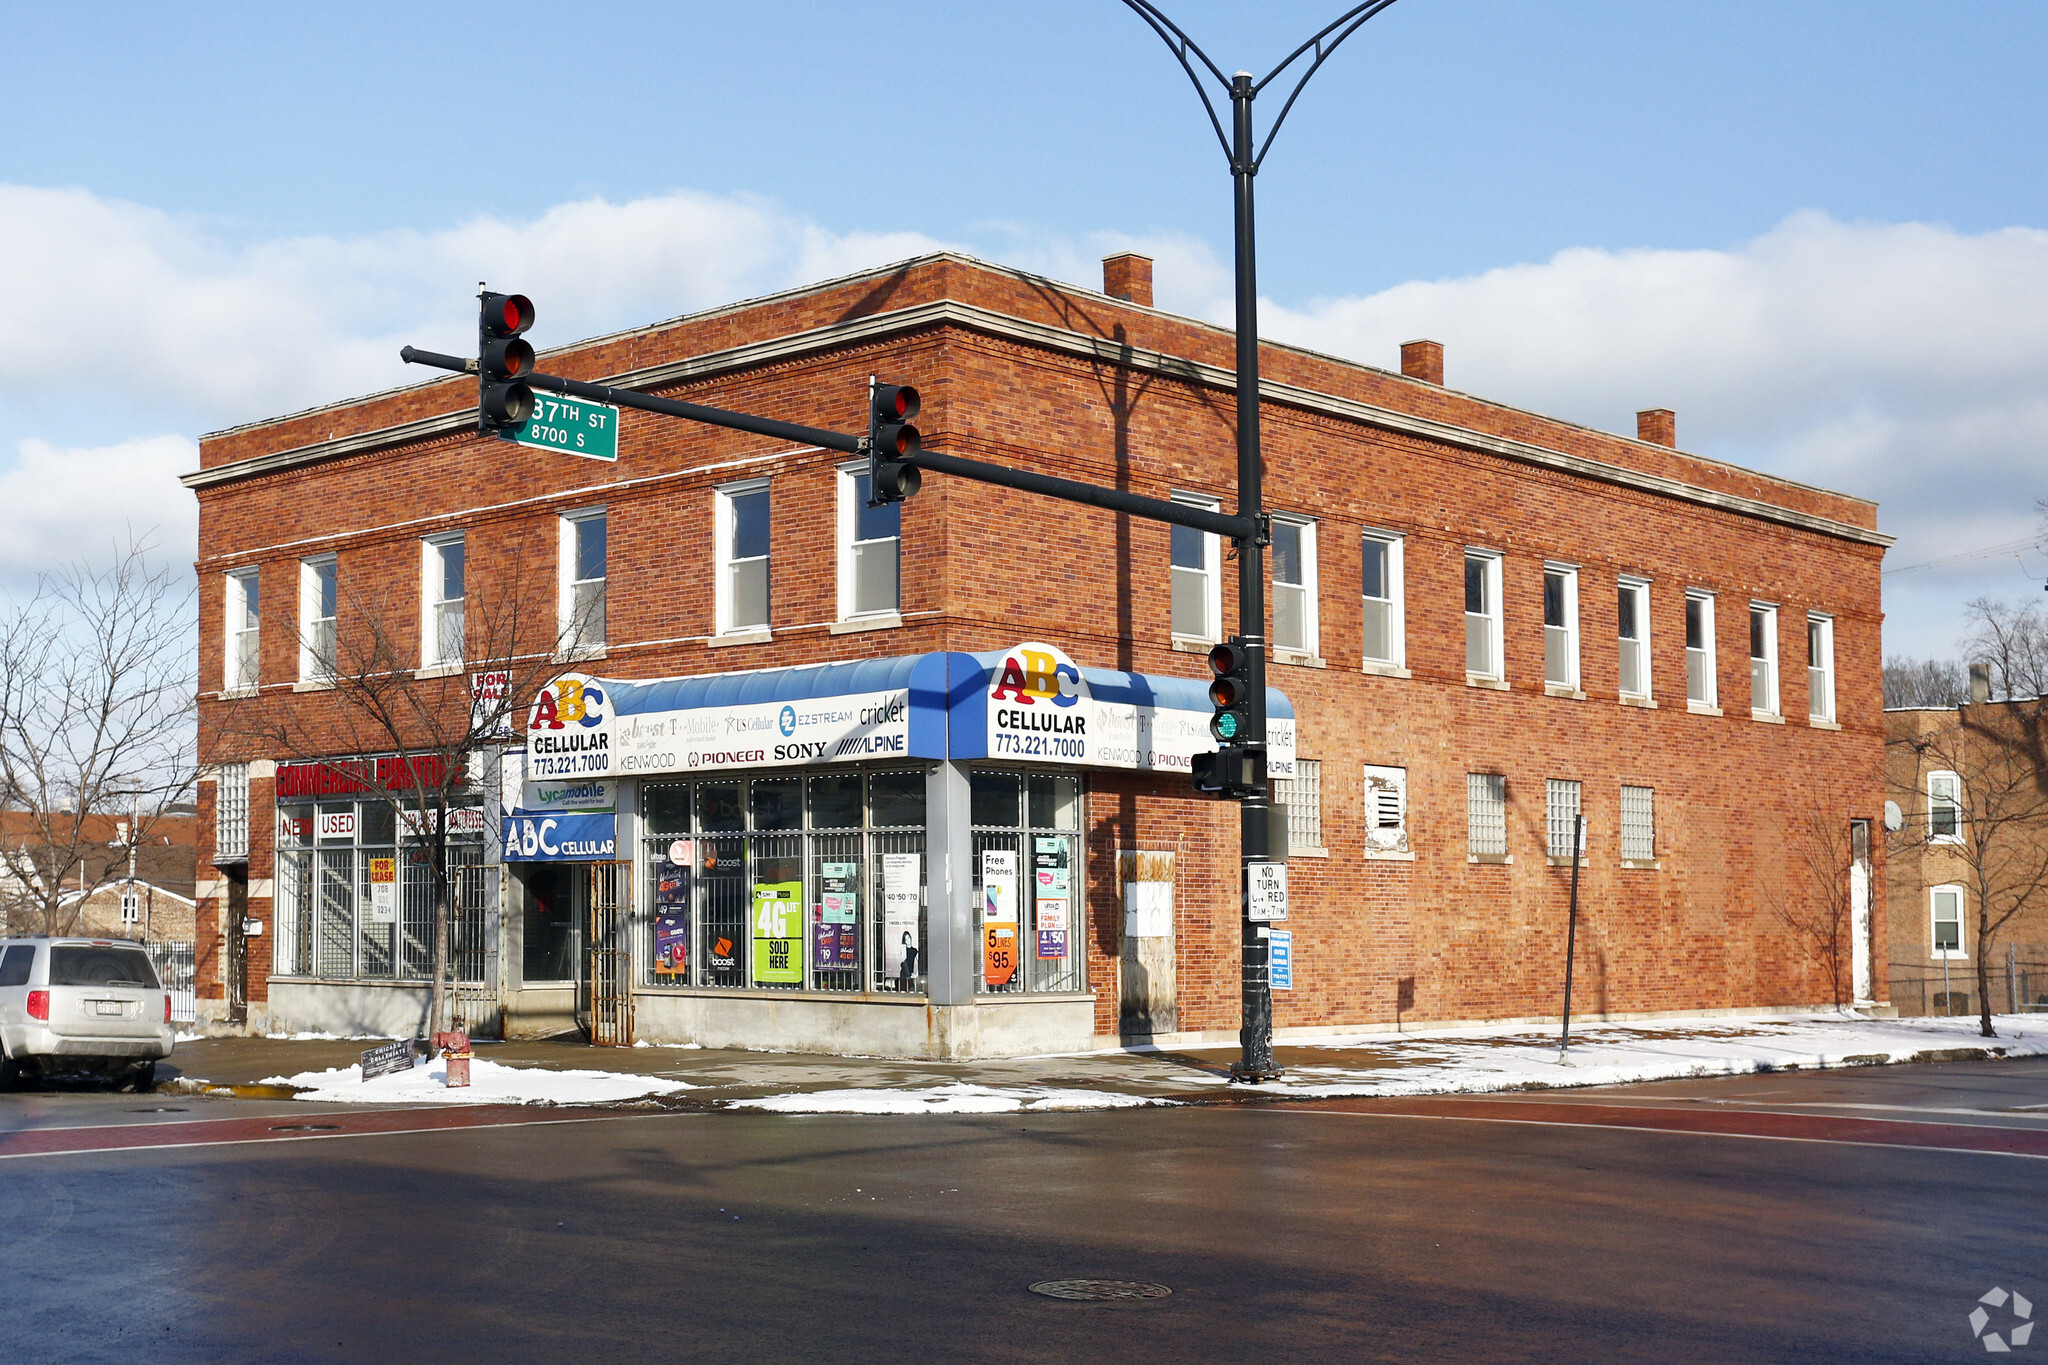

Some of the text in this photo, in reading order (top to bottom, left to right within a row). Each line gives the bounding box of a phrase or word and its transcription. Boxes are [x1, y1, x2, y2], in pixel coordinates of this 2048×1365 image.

[588, 413, 606, 429] ST
[531, 424, 584, 448] 8700 S
[991, 649, 1080, 708] ABC
[530, 679, 604, 730] ABC
[798, 710, 853, 726] EZSTREAM
[860, 694, 905, 726] cricket
[997, 708, 1086, 734] CELLULAR
[534, 732, 609, 754] CELLULAR
[620, 734, 904, 770] KENWOOD PIONEER SONY ALPINE
[996, 734, 1085, 758] 773.221.7000
[534, 753, 609, 776] 773.221.7000
[1097, 747, 1142, 764] KENWOOD
[1158, 754, 1194, 767] PIONE
[275, 753, 464, 798] COMMERCIAL FURNITUE
[537, 782, 604, 804] Lycamobile
[282, 816, 314, 836] NEW
[322, 816, 354, 834] USED
[504, 818, 614, 857] ABC CELLULAR
[374, 860, 390, 870] FOR
[717, 858, 741, 867] boost
[985, 855, 1005, 865] Free
[371, 872, 394, 882] LEASE
[985, 867, 1013, 876] Phones
[1262, 867, 1274, 878] NO
[1257, 880, 1279, 890] TURN
[1268, 892, 1284, 902] RED
[757, 900, 798, 939] 4G LTE
[769, 941, 789, 954] SOLD
[988, 929, 997, 948] 5
[712, 957, 735, 966] boost
[769, 956, 789, 969] HERE
[988, 952, 1009, 968] $95
